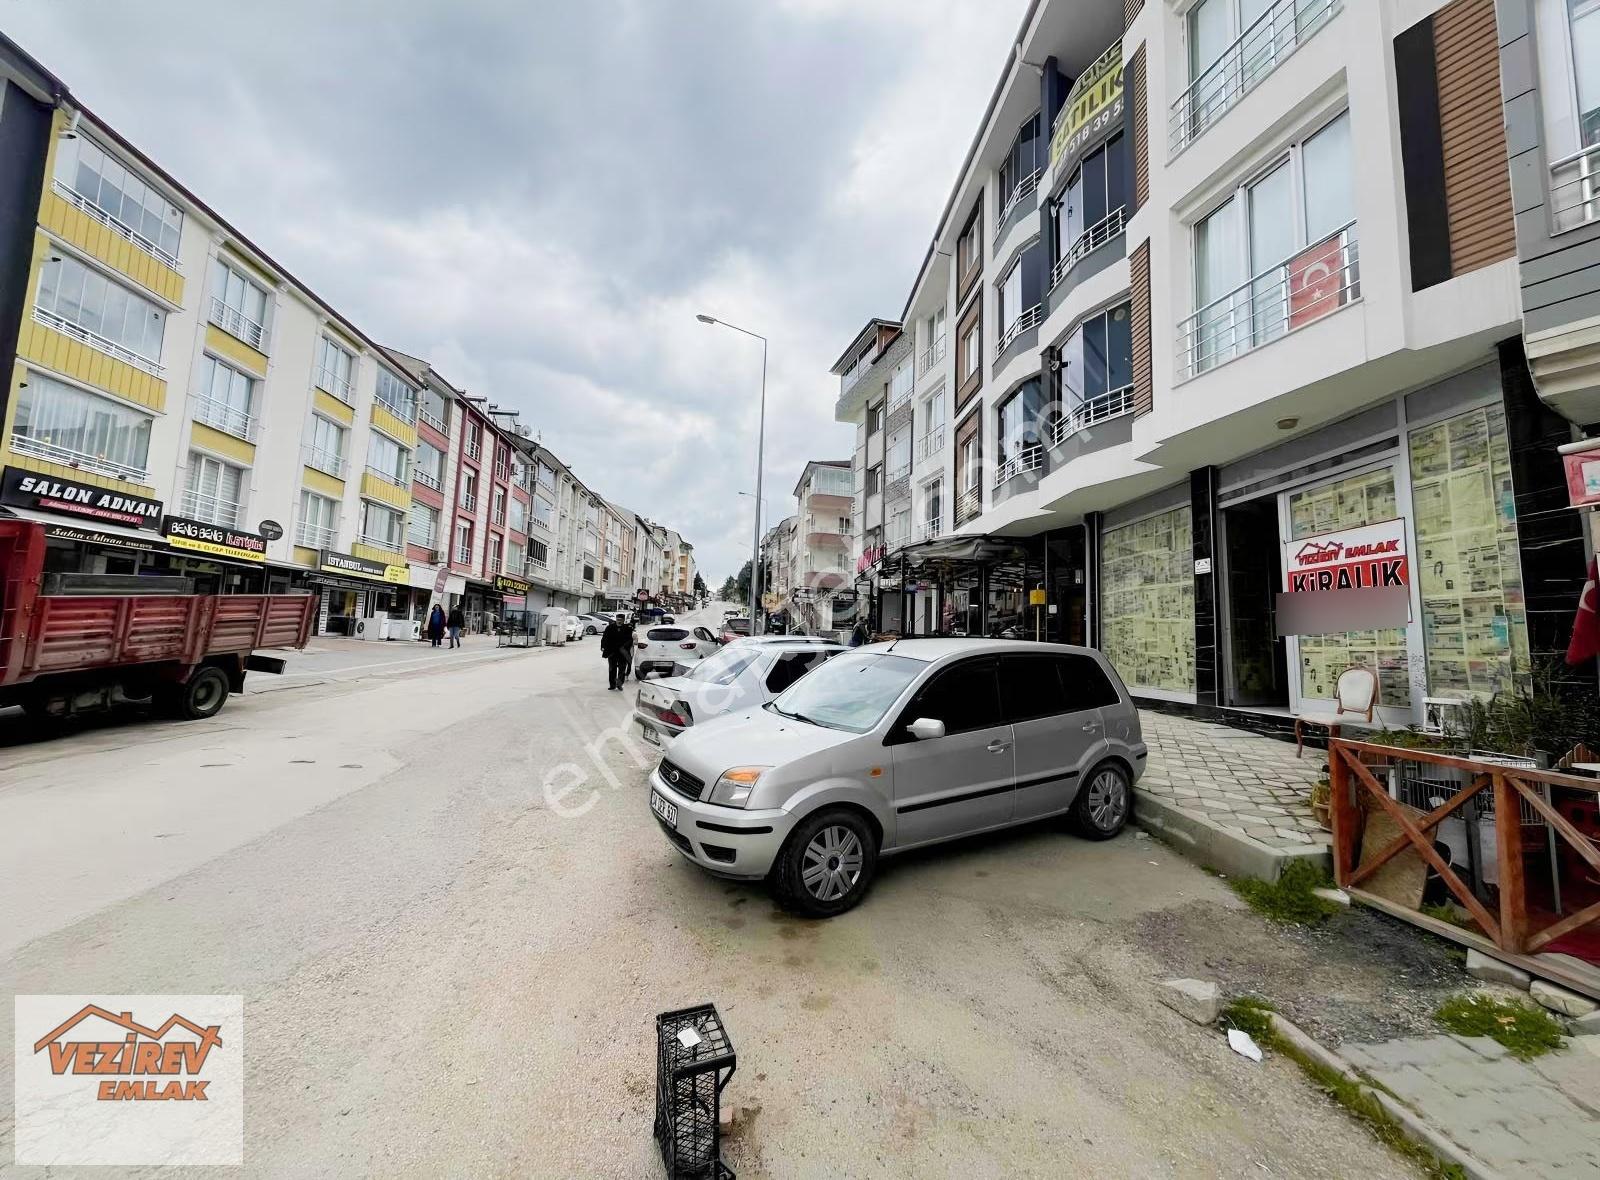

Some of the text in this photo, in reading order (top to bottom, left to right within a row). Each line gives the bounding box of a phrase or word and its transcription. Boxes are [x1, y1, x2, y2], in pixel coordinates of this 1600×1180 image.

[1093, 111, 1109, 132] 39
[19, 477, 94, 504] SALON
[97, 495, 161, 518] ADNAN
[171, 522, 198, 537] BENG
[199, 528, 223, 542] BENG
[1345, 539, 1400, 558] EMLAK
